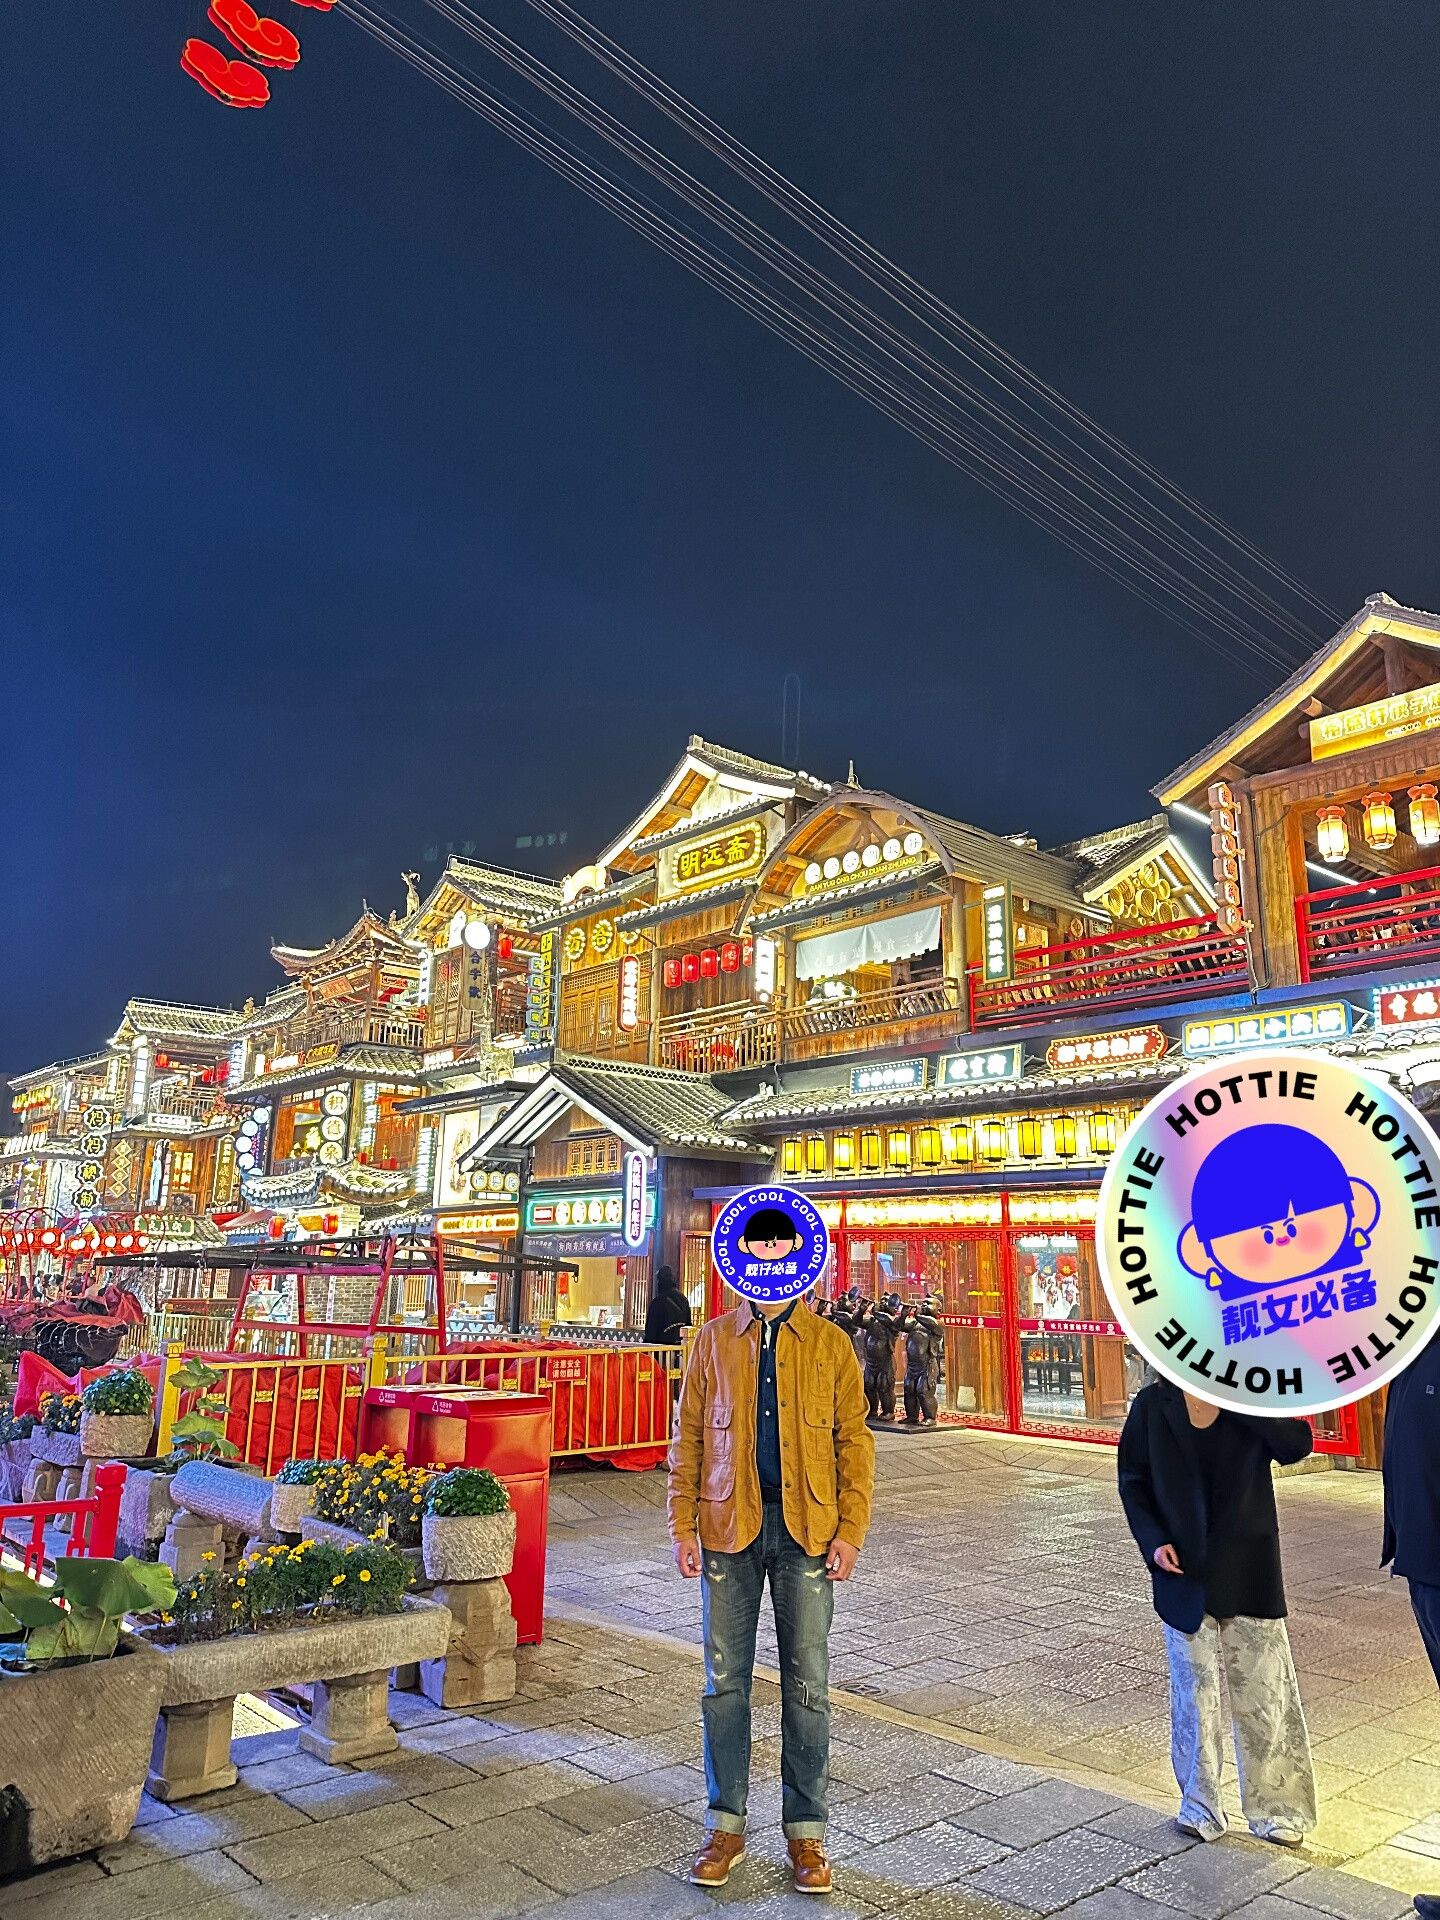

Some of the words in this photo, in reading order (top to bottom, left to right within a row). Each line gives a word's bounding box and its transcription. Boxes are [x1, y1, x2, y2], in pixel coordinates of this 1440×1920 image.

[681, 835, 751, 877] 明远斋
[325, 1094, 344, 1161] 积德泉
[552, 1359, 581, 1369] 注意安全
